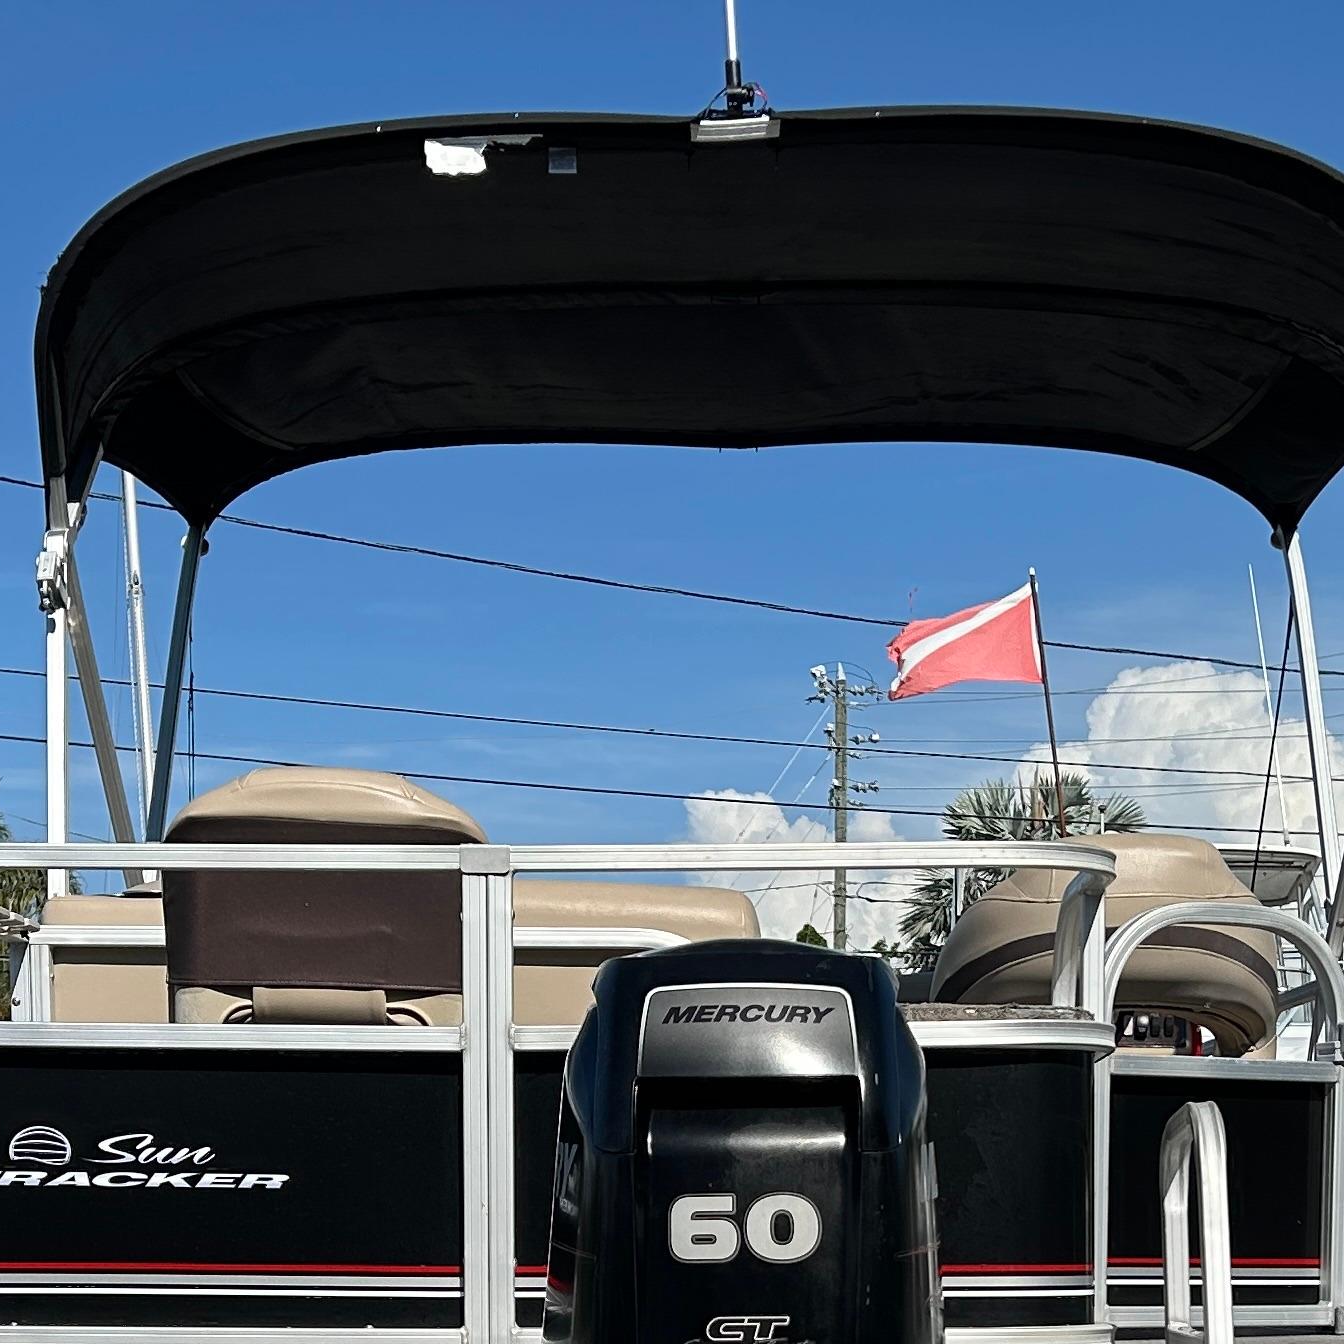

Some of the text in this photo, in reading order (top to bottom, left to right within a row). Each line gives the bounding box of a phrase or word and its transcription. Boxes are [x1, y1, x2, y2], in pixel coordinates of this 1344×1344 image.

[662, 1004, 835, 1025] MERCURY
[78, 1133, 216, 1165] Sun
[668, 1191, 823, 1264] 60
[706, 1315, 790, 1341] GT
